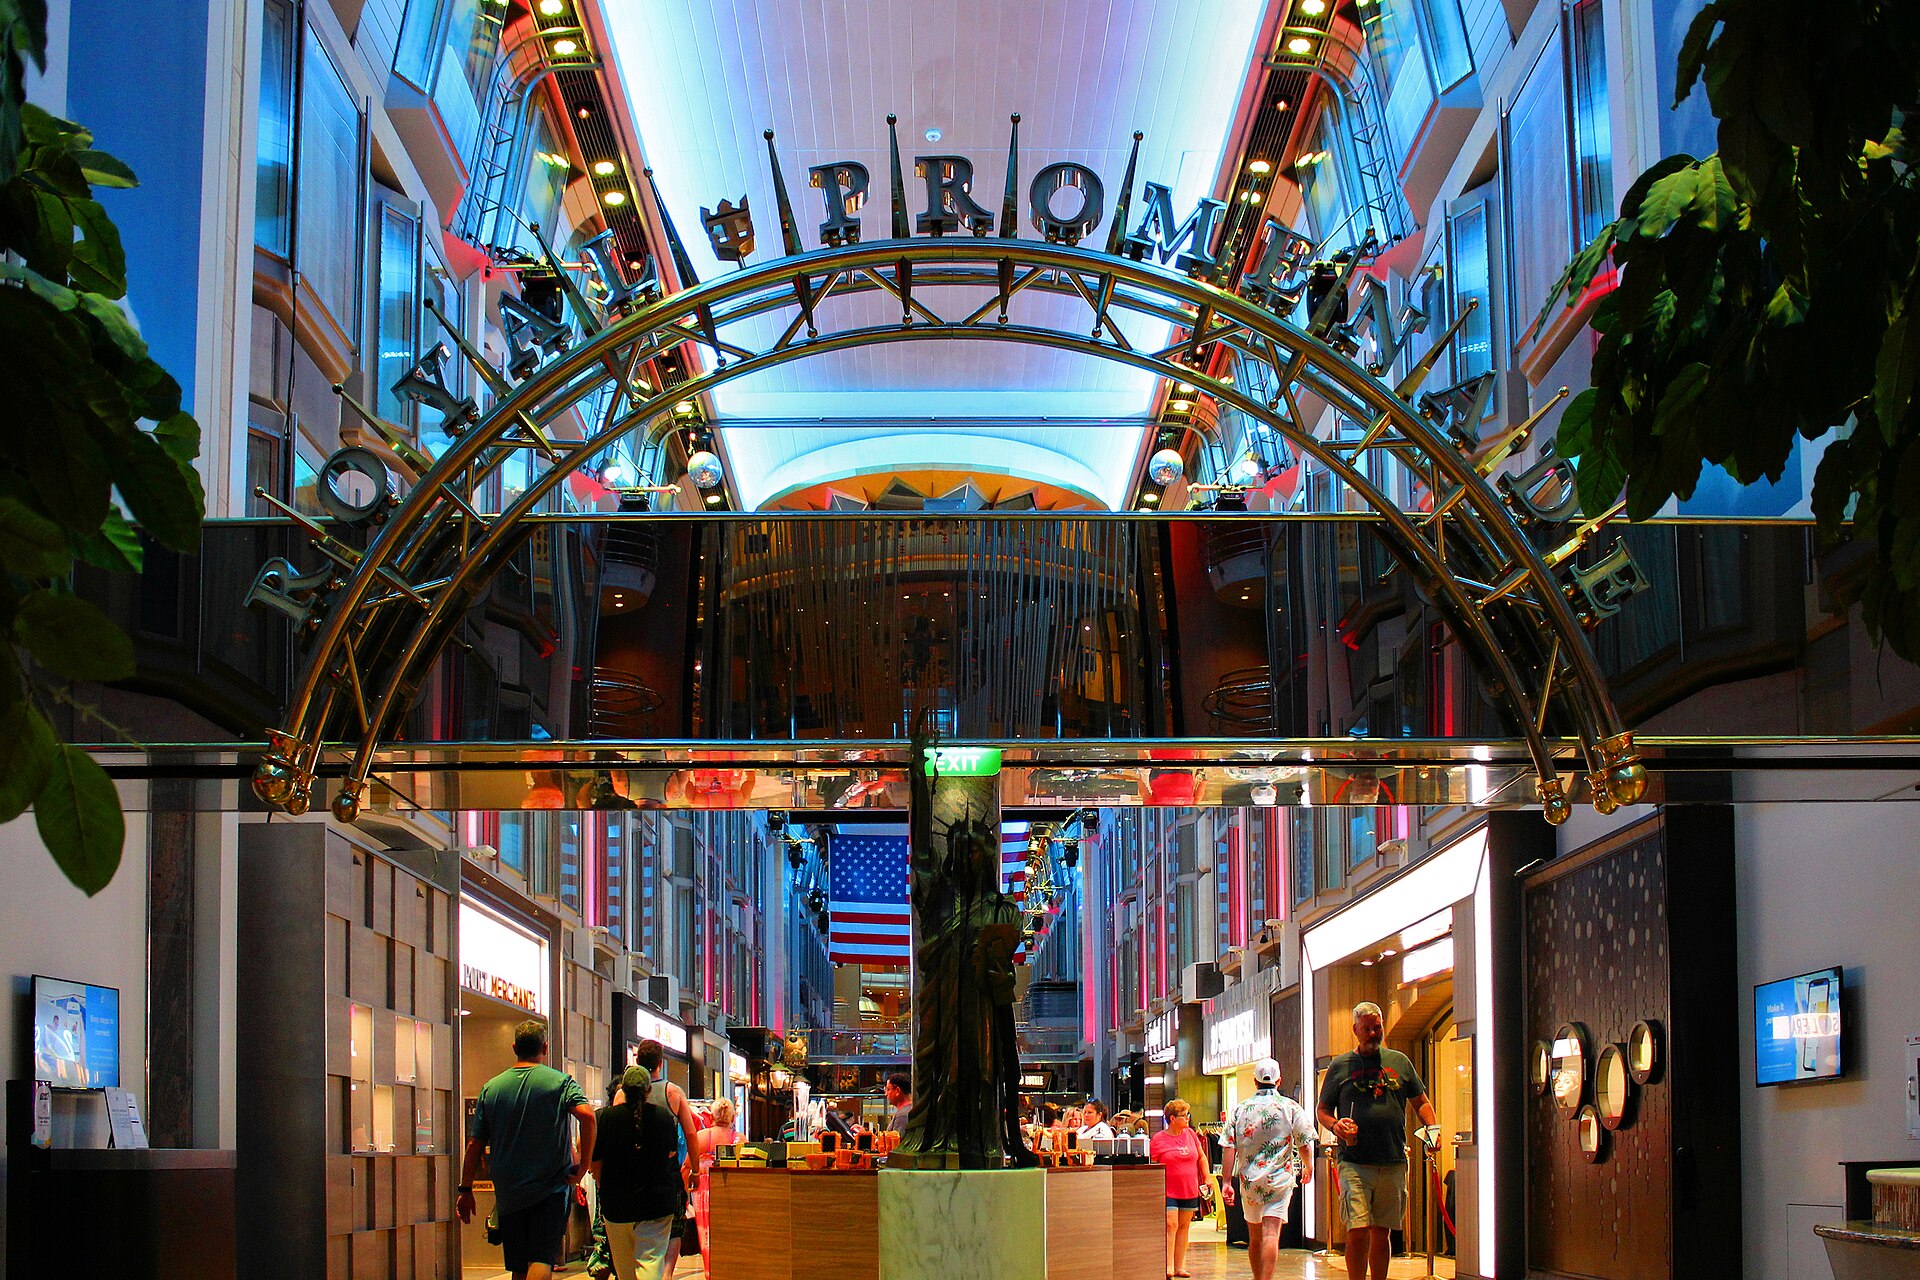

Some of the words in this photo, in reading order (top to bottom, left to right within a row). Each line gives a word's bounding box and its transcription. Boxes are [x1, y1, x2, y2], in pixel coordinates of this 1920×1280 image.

[243, 227, 659, 634] ROYAL
[809, 160, 1651, 620] PROMENADE
[936, 755, 980, 771] EXIT
[491, 974, 536, 1012] MERCHANTS
